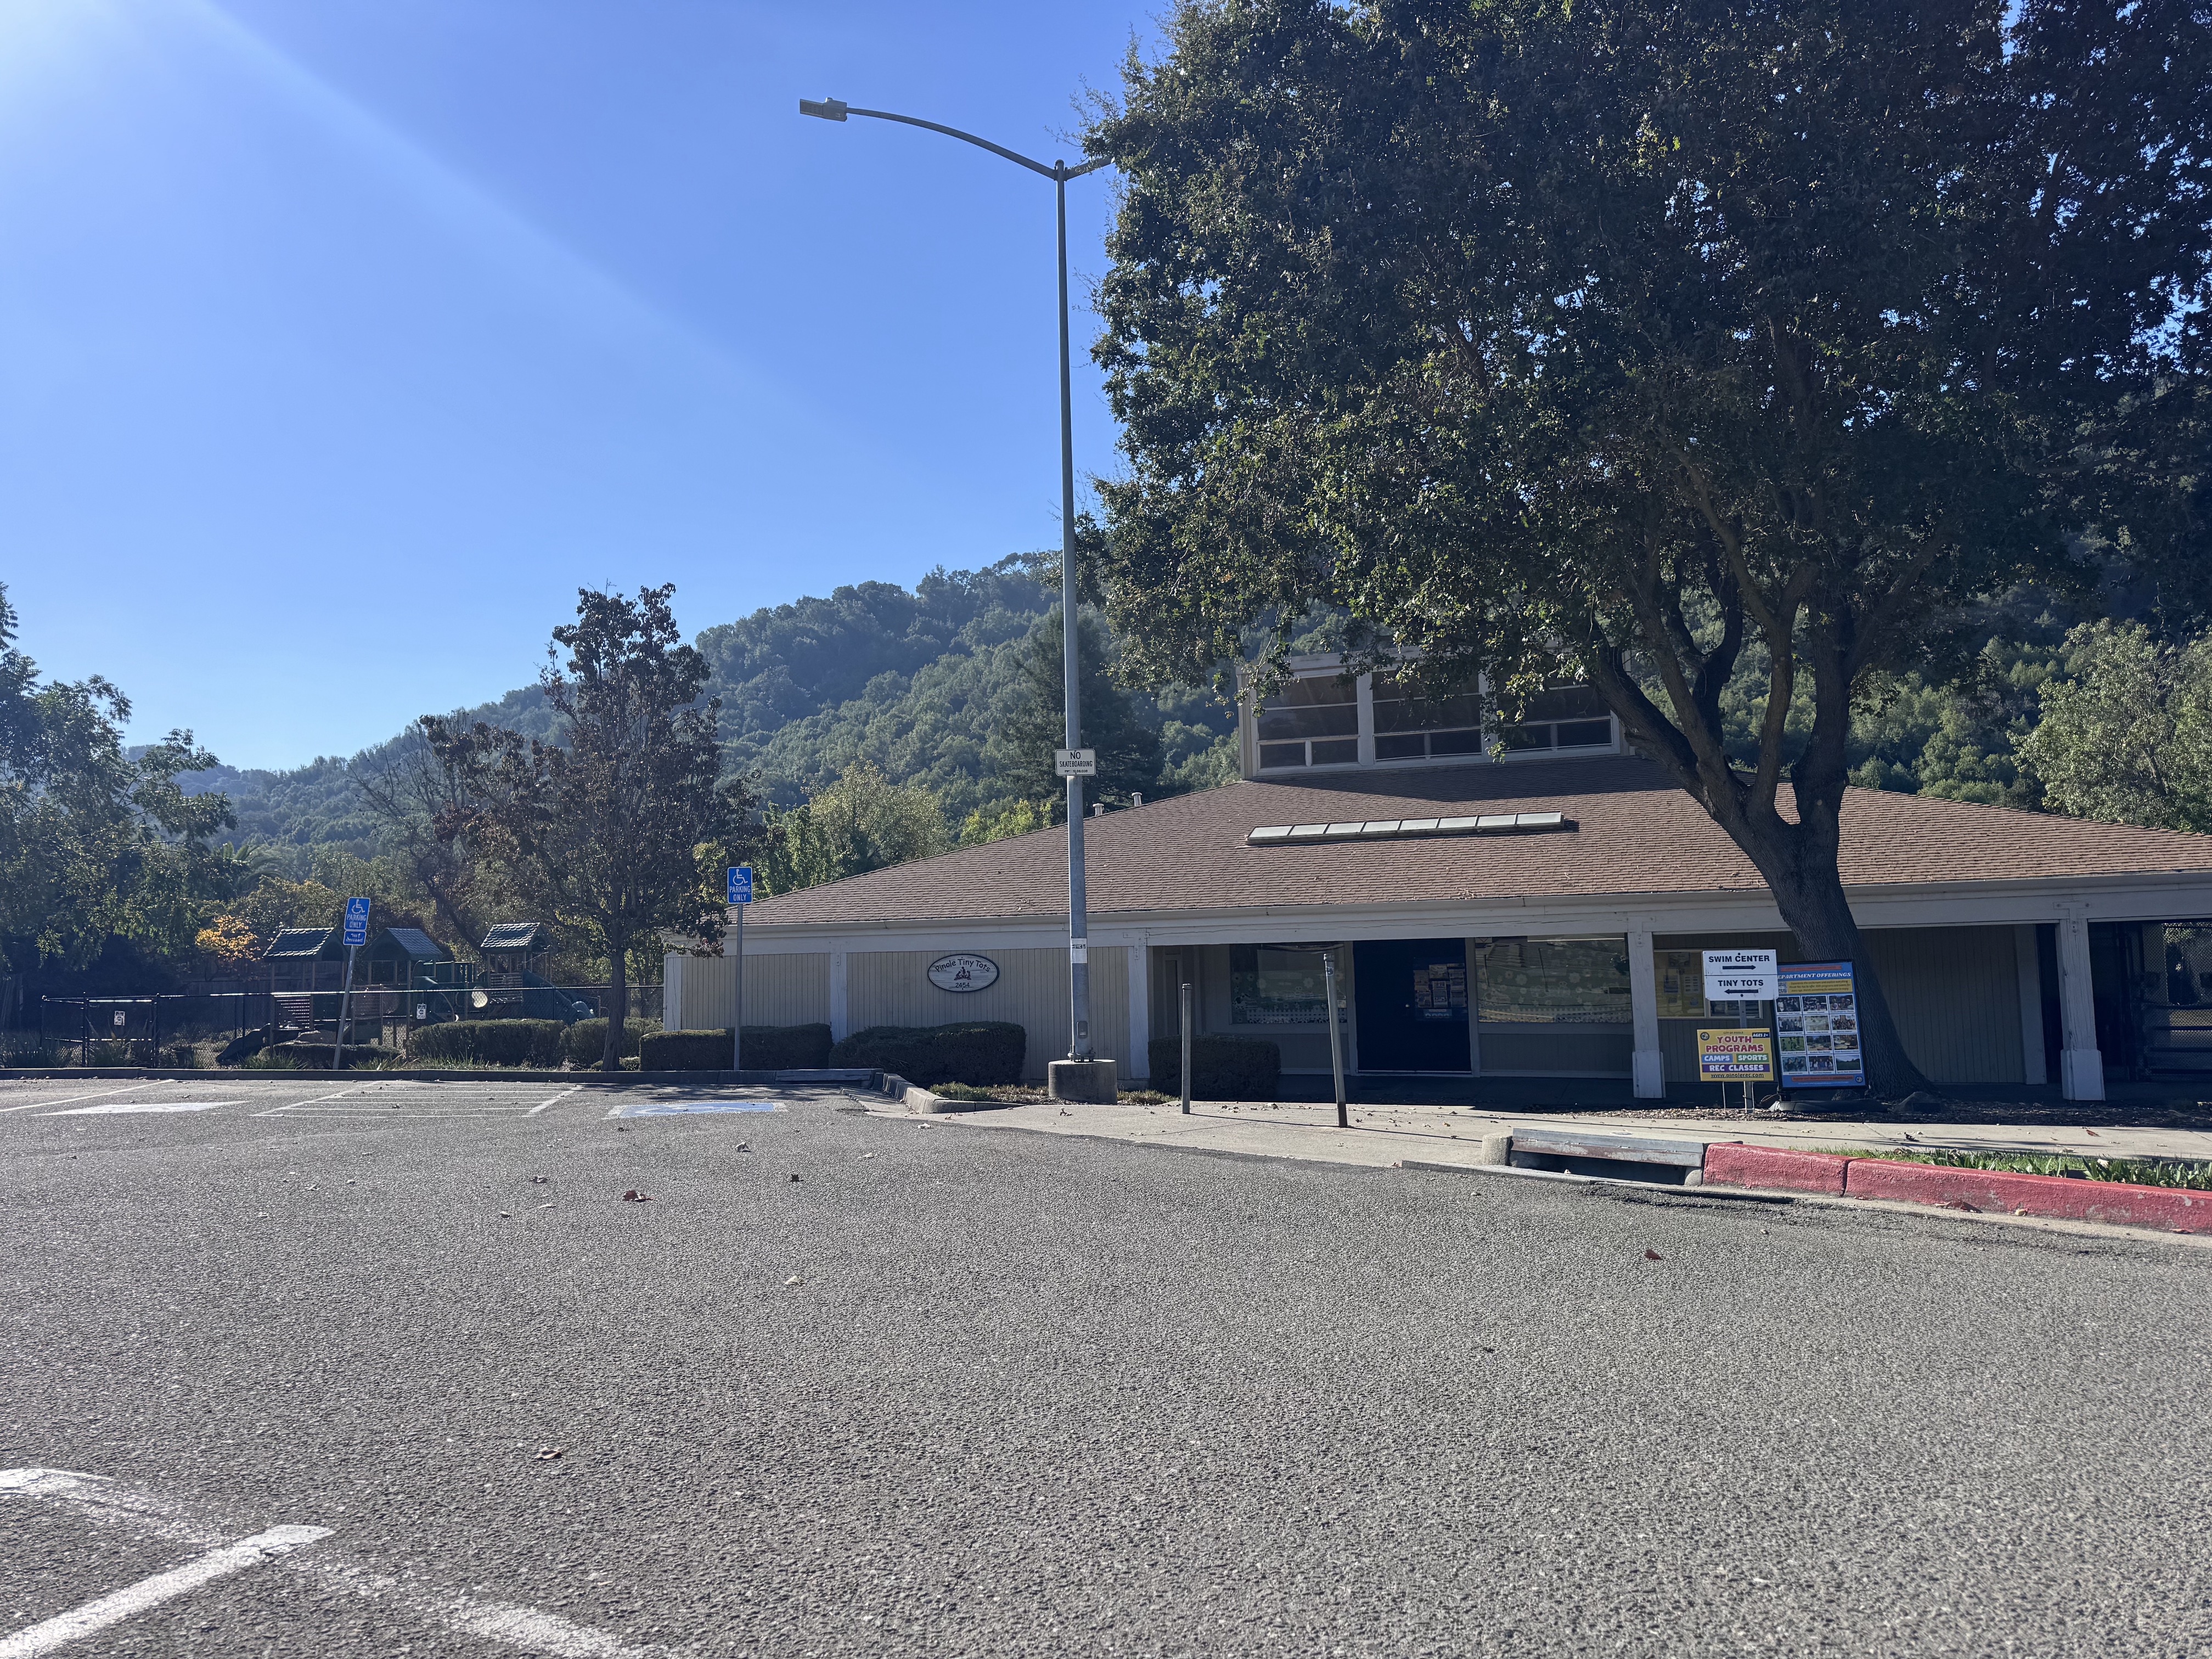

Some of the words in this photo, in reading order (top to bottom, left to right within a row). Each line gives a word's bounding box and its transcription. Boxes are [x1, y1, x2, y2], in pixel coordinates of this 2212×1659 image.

[935, 960, 956, 972] Pinole
[958, 959, 974, 967] Tiny
[976, 960, 990, 972] Tots
[1706, 1044, 1764, 1053] PROGRAMS
